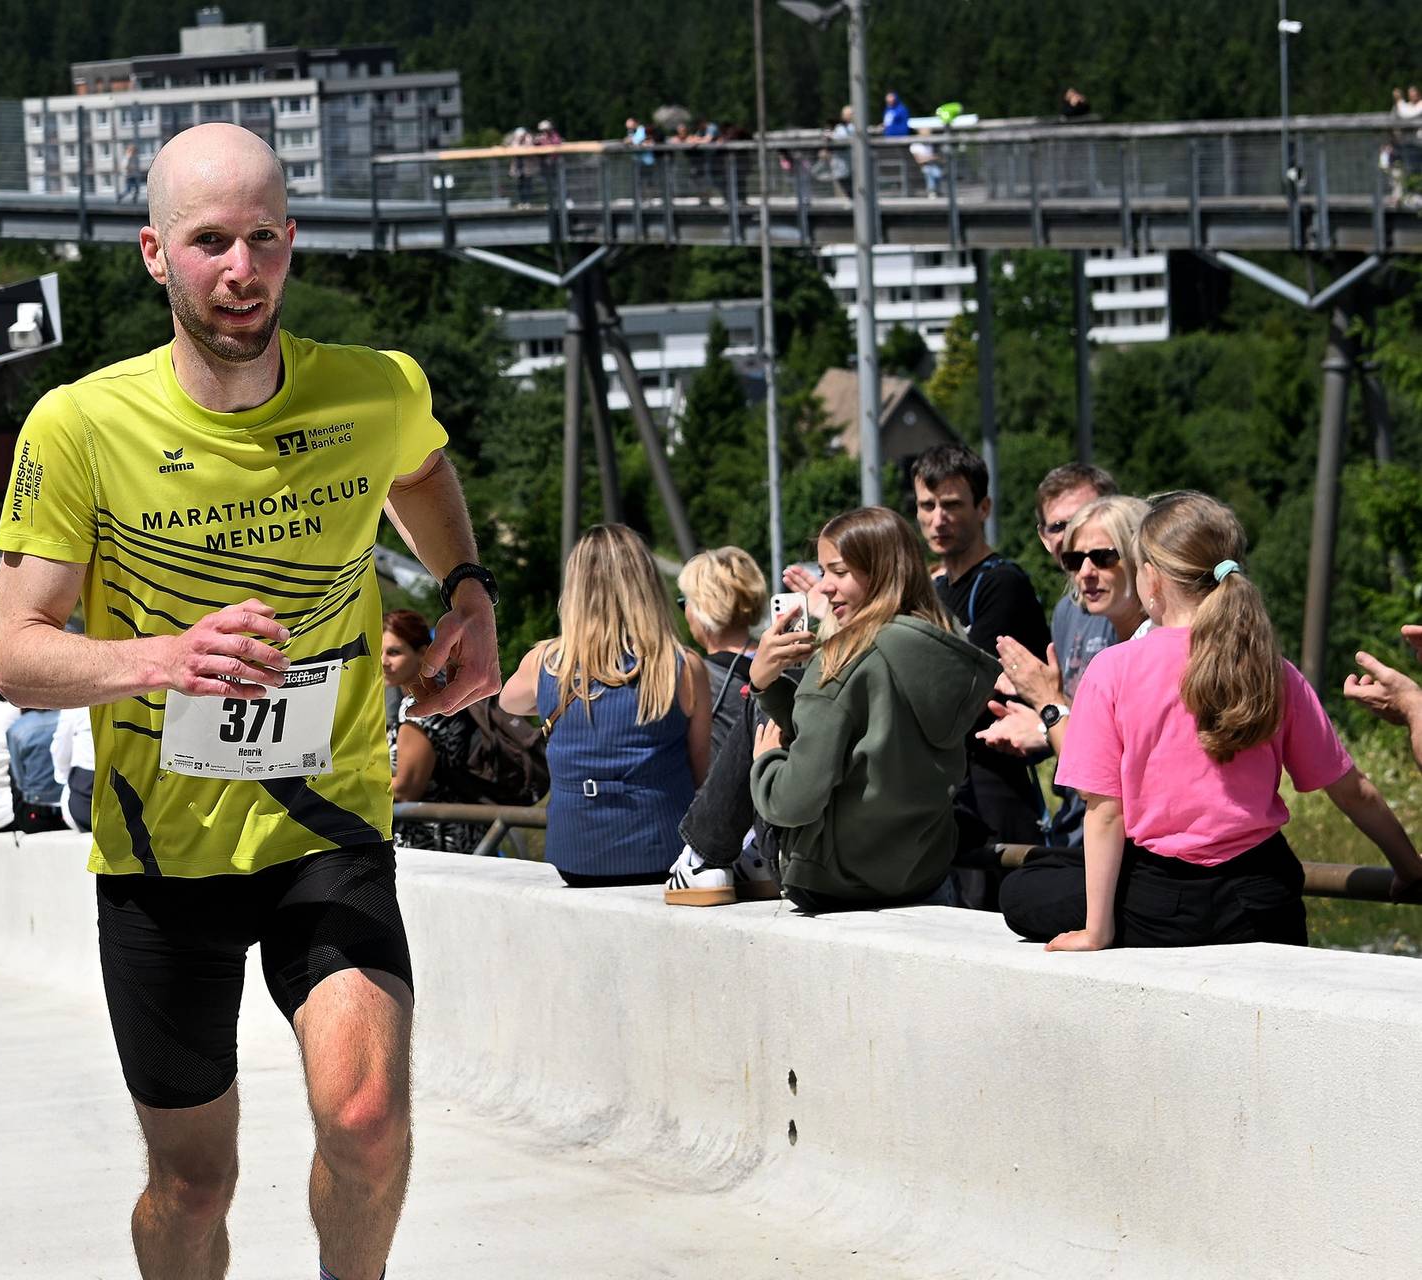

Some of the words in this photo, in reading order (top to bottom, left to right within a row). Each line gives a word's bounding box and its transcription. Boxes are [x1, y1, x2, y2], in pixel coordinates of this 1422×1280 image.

[308, 422, 355, 438] Mendener
[311, 437, 336, 450] Bank
[338, 432, 352, 444] eG
[13, 440, 30, 511] INTERSPORT
[24, 460, 34, 497] HESSE
[34, 464, 43, 501] MENDEN
[159, 462, 194, 474] erima
[141, 476, 370, 530] MARATHON-CLUB
[205, 516, 322, 550] MENDEN
[219, 698, 288, 743] 371
[238, 747, 263, 757] Henrik
